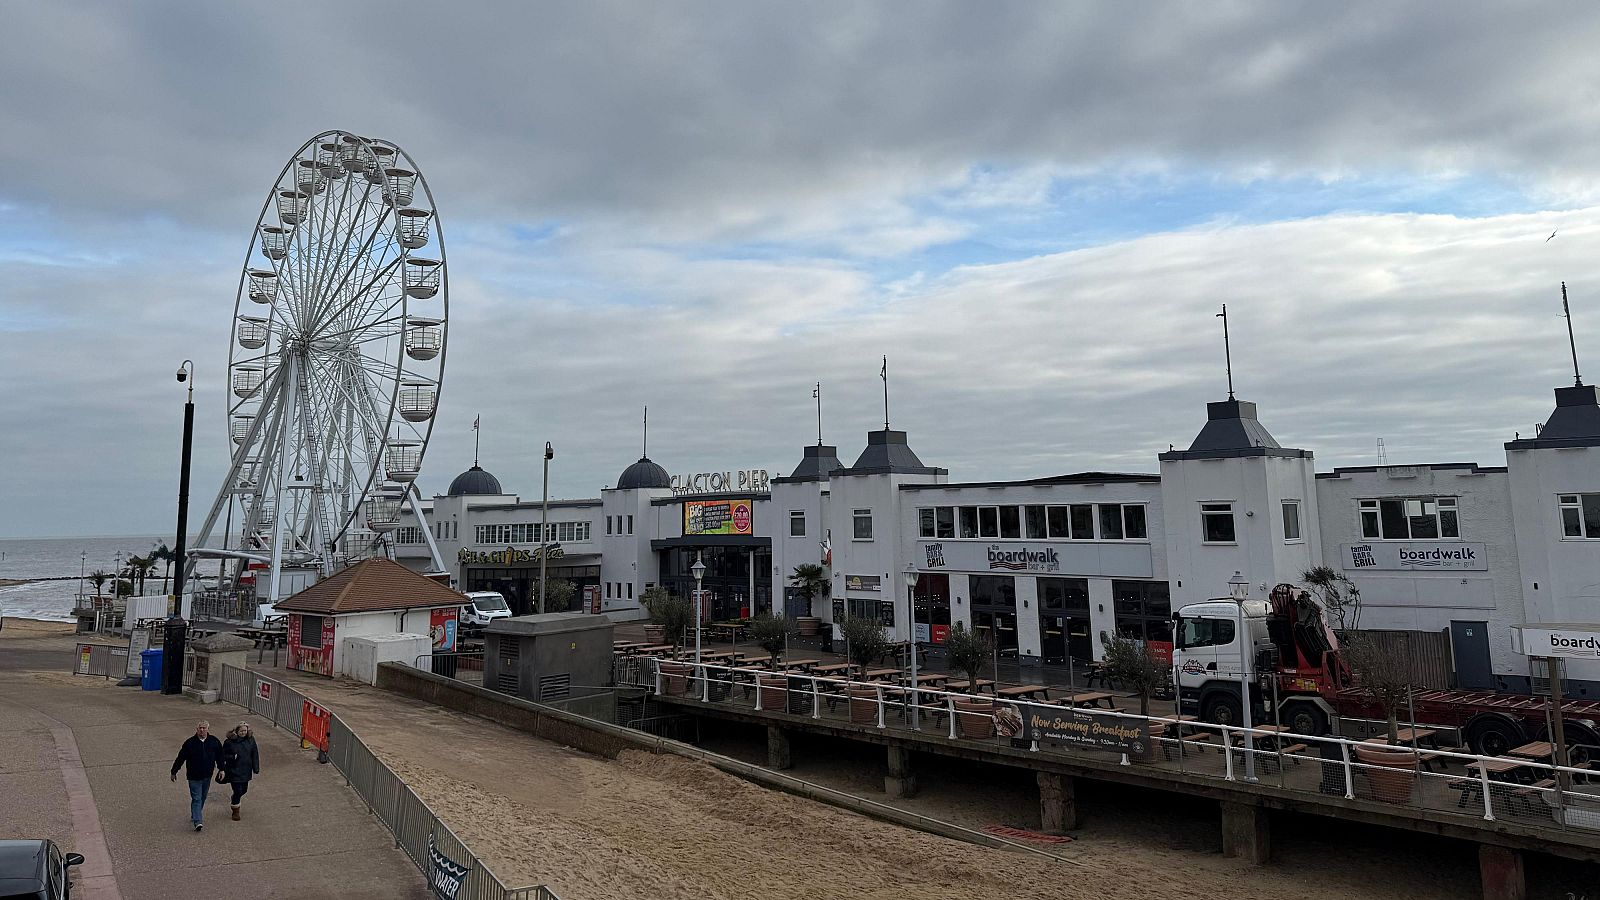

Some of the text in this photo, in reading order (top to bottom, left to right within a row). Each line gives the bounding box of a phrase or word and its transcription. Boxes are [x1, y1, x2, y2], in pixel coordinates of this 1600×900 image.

[669, 470, 769, 491] CLACTON PIER
[987, 547, 1059, 562] boardwalk
[1399, 548, 1475, 559] boardwalk
[927, 557, 946, 568] GRILL
[1354, 558, 1376, 568] GRILL
[1031, 714, 1050, 728] Now
[1053, 717, 1088, 736] Serving
[1092, 722, 1141, 741] Breakfast
[435, 868, 459, 899] WATER
